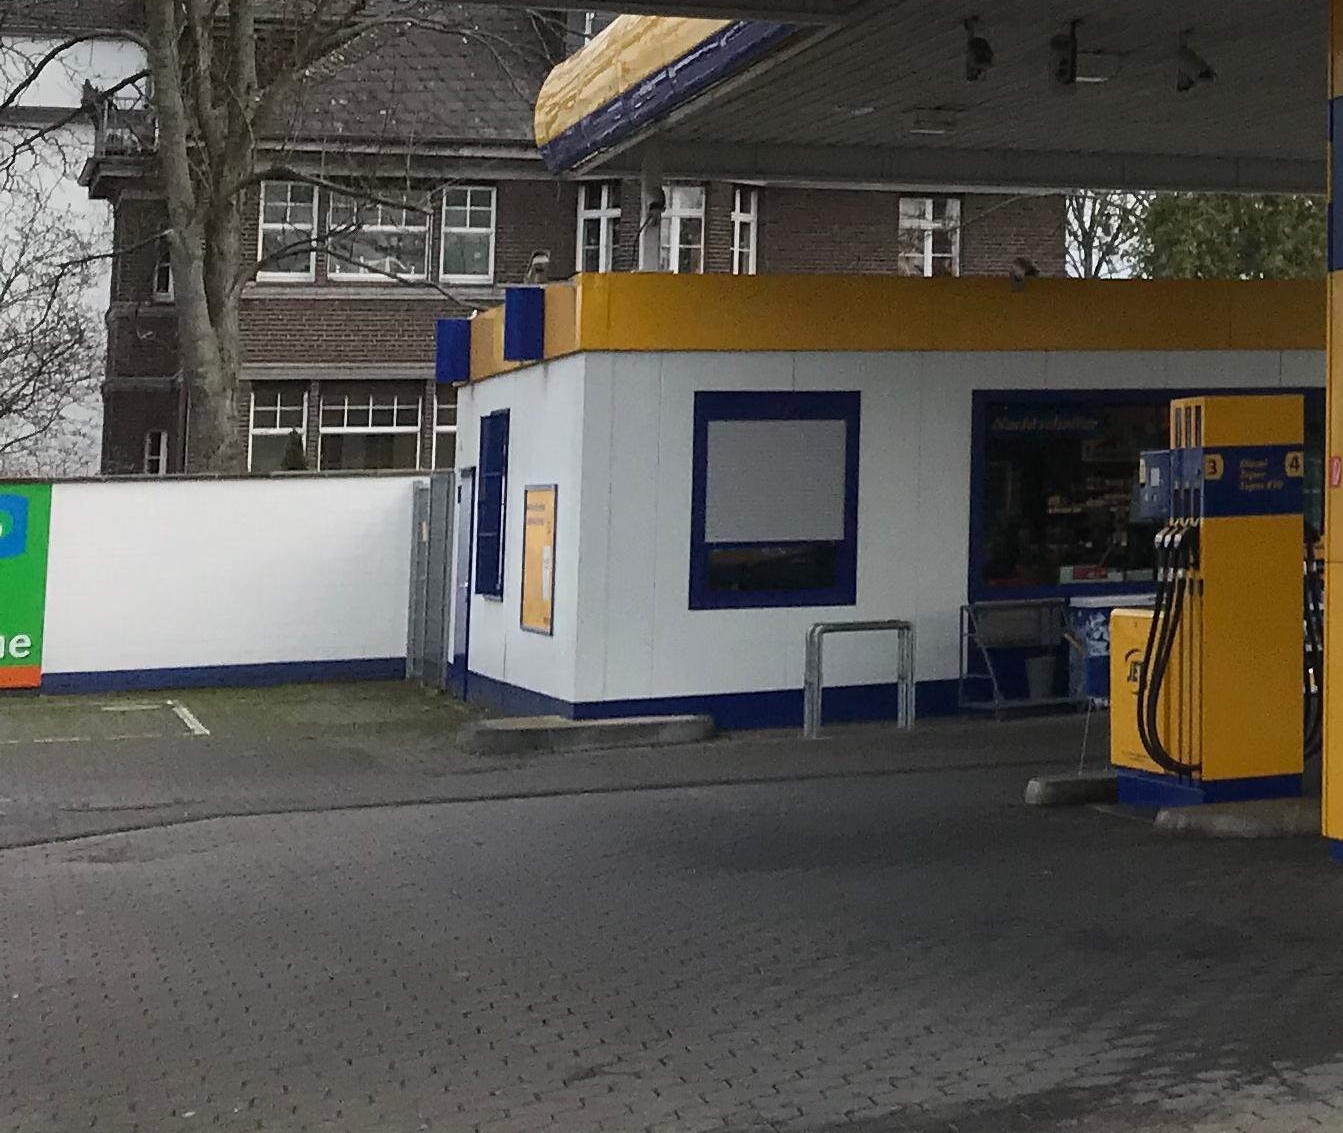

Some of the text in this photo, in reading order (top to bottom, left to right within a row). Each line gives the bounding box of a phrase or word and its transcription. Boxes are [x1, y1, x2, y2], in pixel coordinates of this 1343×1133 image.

[1208, 458, 1218, 476] 3
[1289, 456, 1300, 473] 4
[0, 633, 32, 658] e
